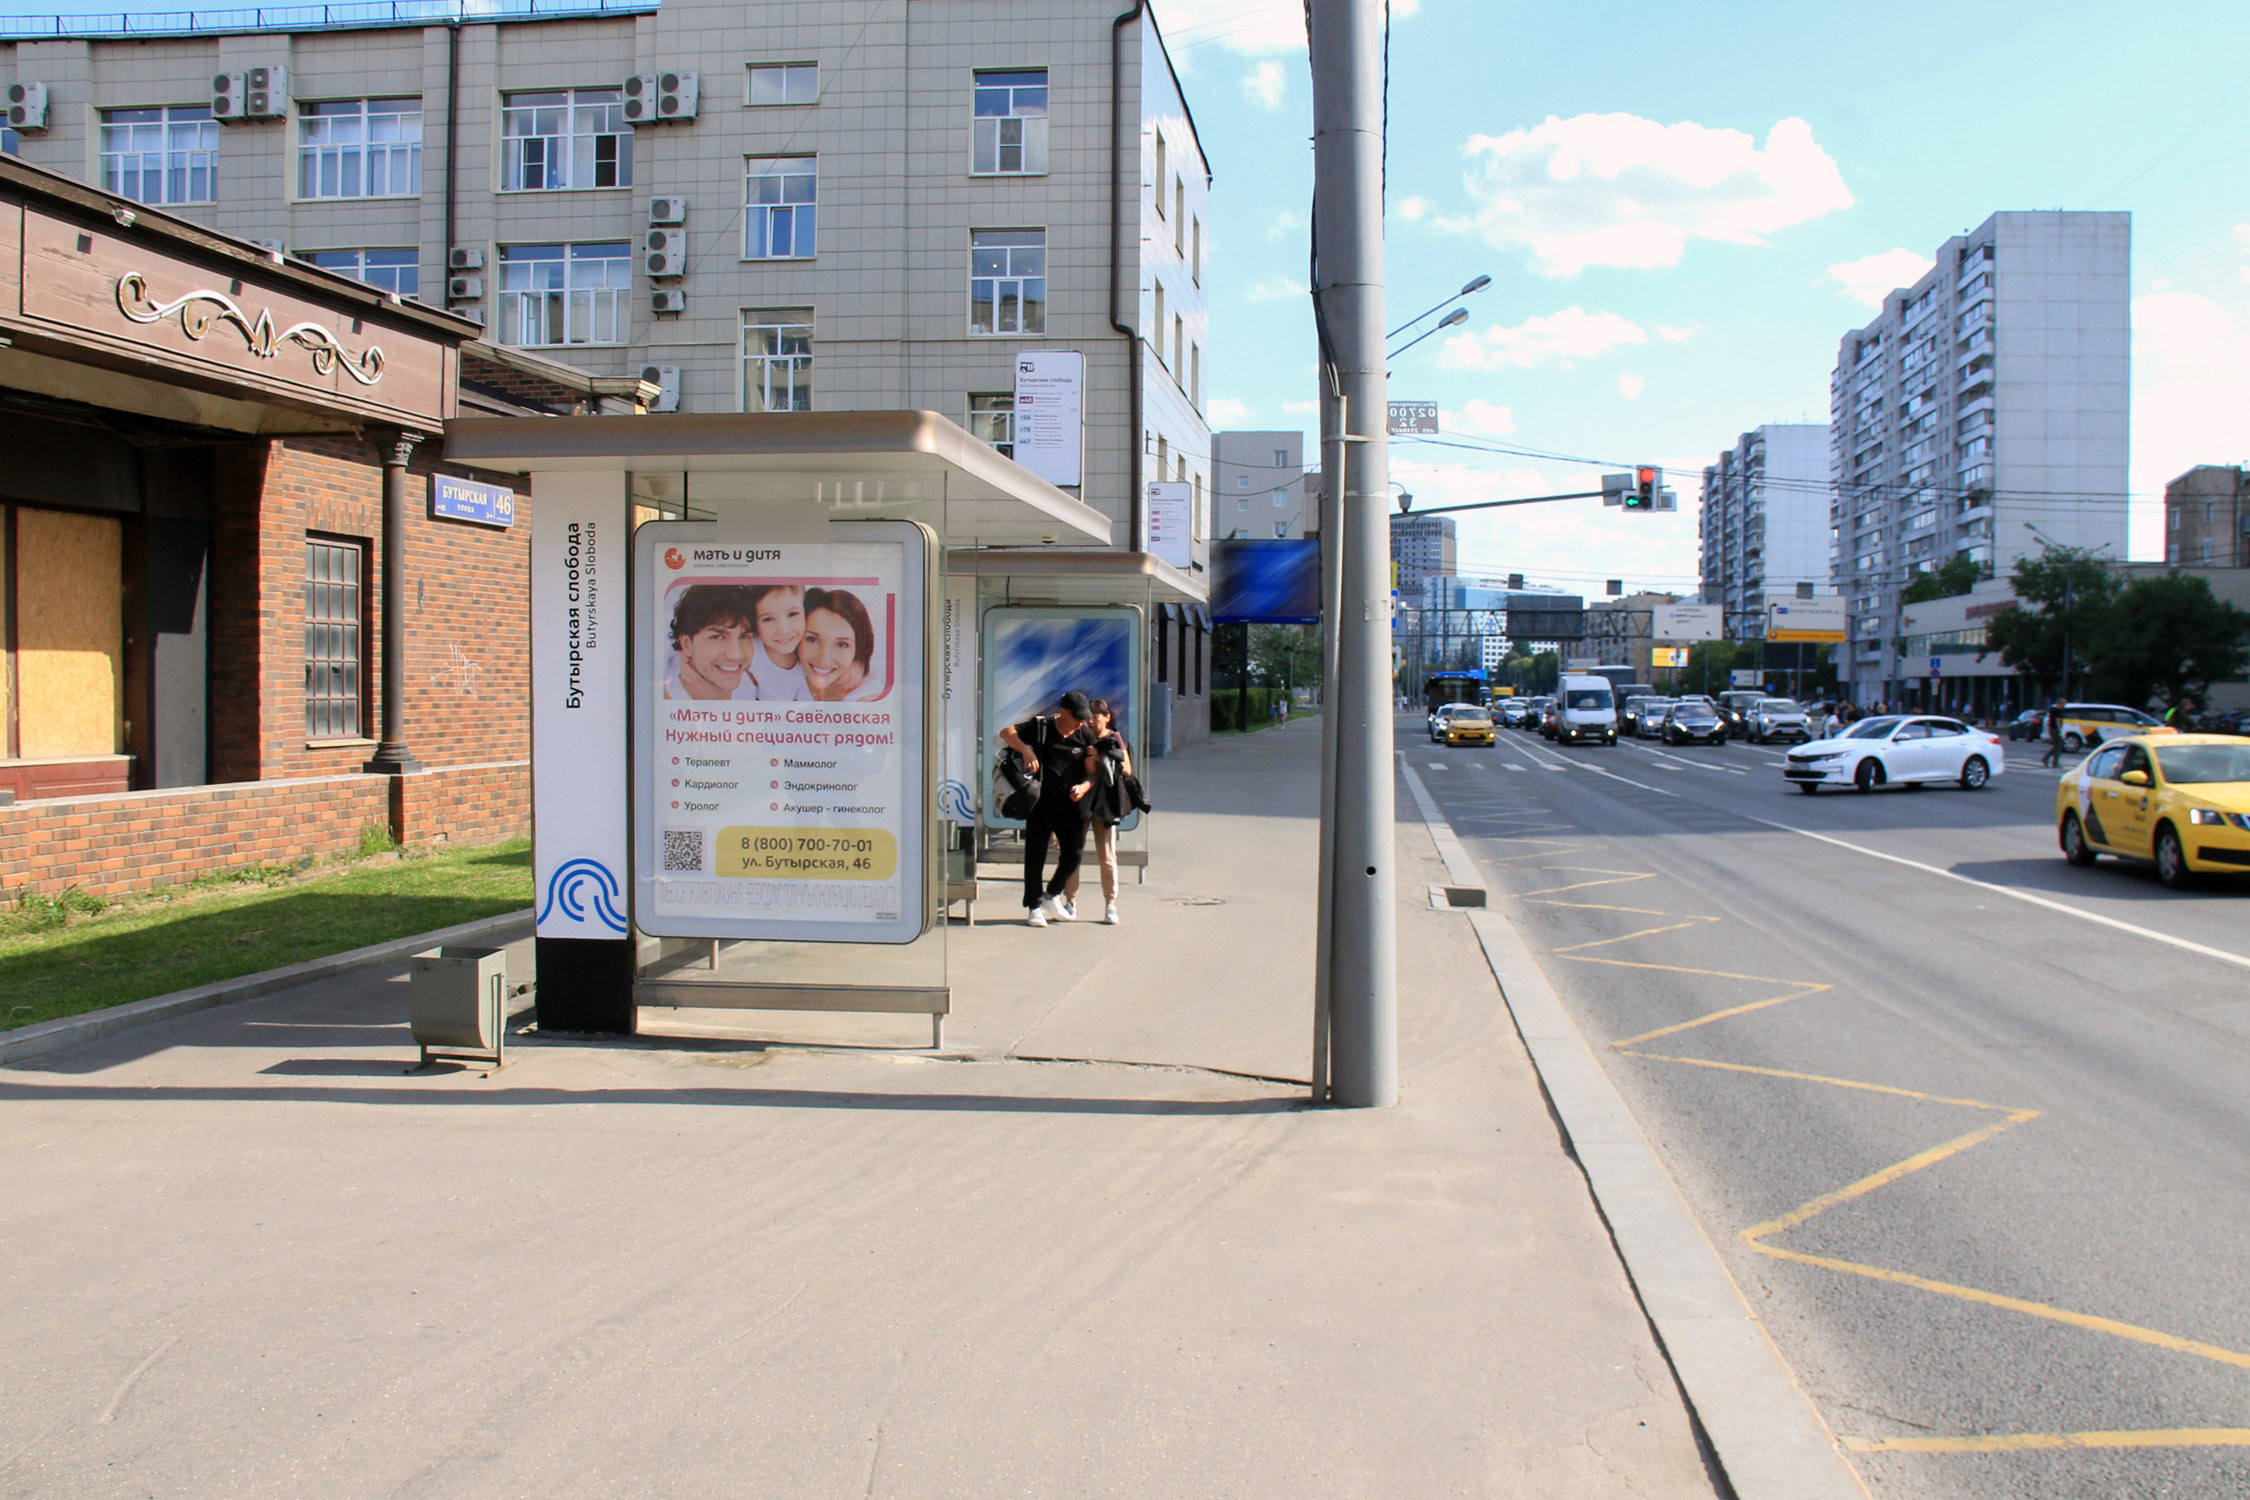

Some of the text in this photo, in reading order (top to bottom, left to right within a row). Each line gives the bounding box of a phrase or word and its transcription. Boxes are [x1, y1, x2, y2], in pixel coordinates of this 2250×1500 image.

[442, 485, 488, 506] БУТЫРСКАЯ
[496, 494, 511, 516] 46
[694, 549, 781, 563] мать и дитя
[585, 522, 599, 649] Butyrskaya Sloboda
[564, 522, 584, 709] Бутырская слобода
[669, 708, 890, 725] «Мать и дитя» Савёловская
[666, 728, 894, 747] Нужный специалист рядом!
[684, 758, 731, 768] Терапевт
[784, 759, 838, 769] Маммолог
[684, 779, 739, 790] Кардиолог
[784, 781, 858, 791] Эндокринолог
[684, 801, 719, 811] Уролог
[783, 803, 823, 814] Акушер
[833, 805, 885, 814] гинеколог
[741, 837, 872, 852] 8 (800) 700-70-01
[742, 856, 872, 871] ул. Бутырская, 46
